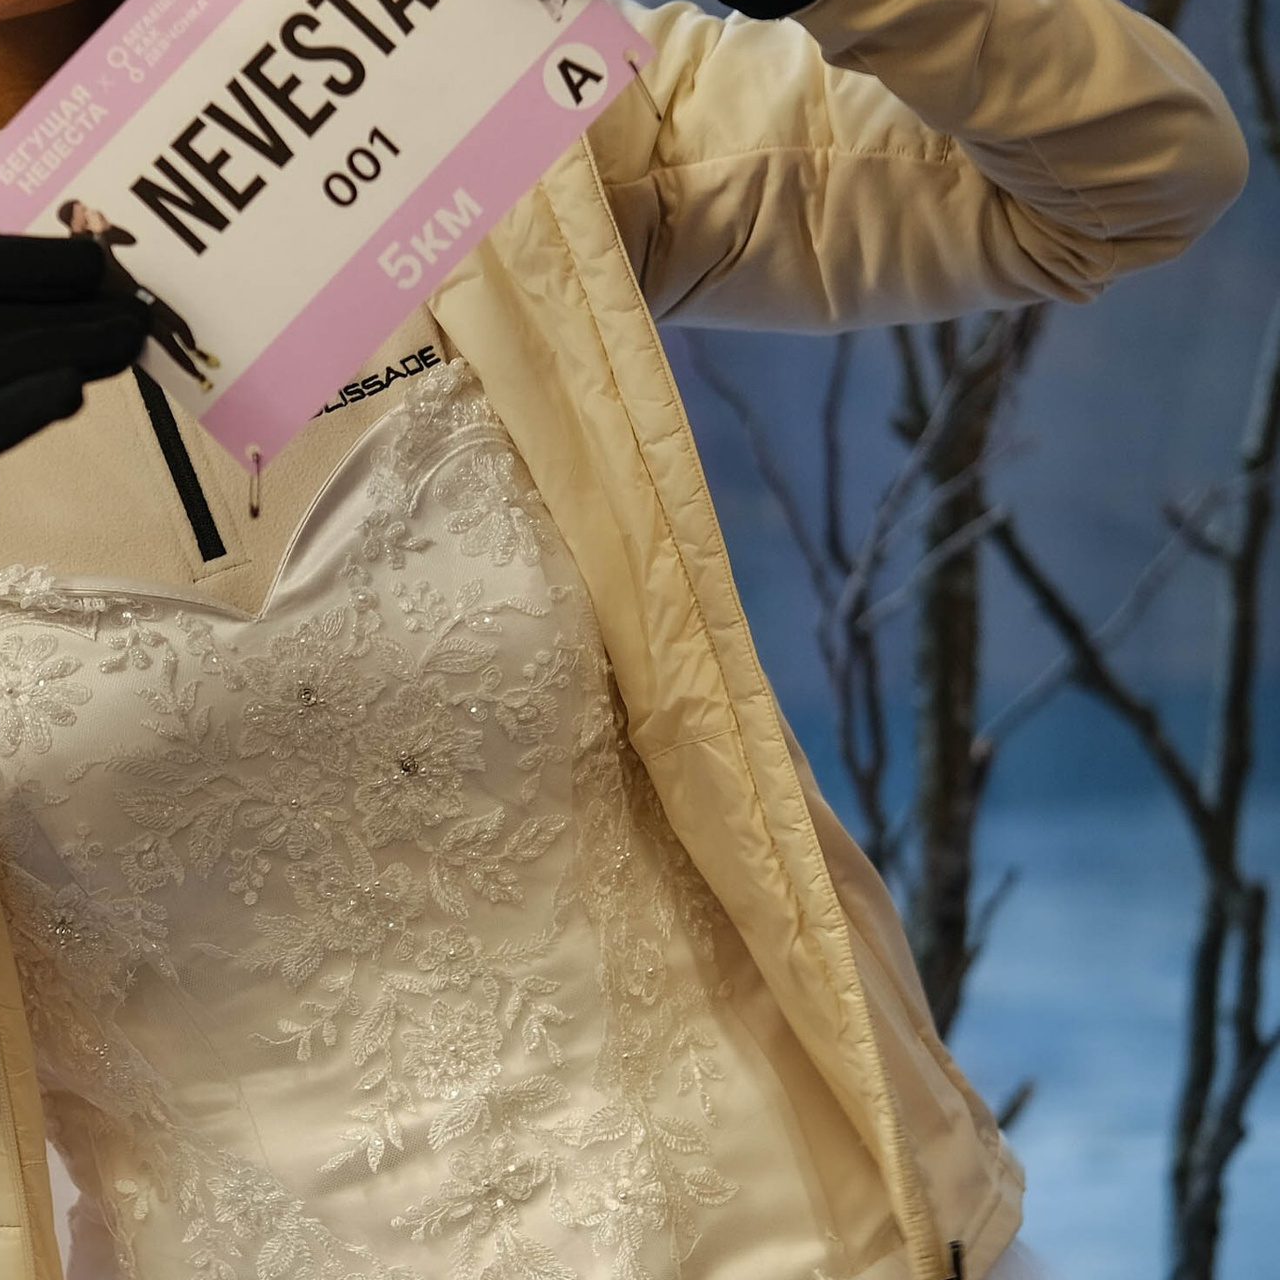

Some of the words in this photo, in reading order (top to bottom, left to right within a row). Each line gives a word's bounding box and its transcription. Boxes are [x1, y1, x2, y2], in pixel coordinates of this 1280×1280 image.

[556, 57, 604, 106] A
[16, 102, 109, 196] НЕВЕСТА
[322, 126, 401, 208] 001
[309, 344, 442, 420] LISSADE
